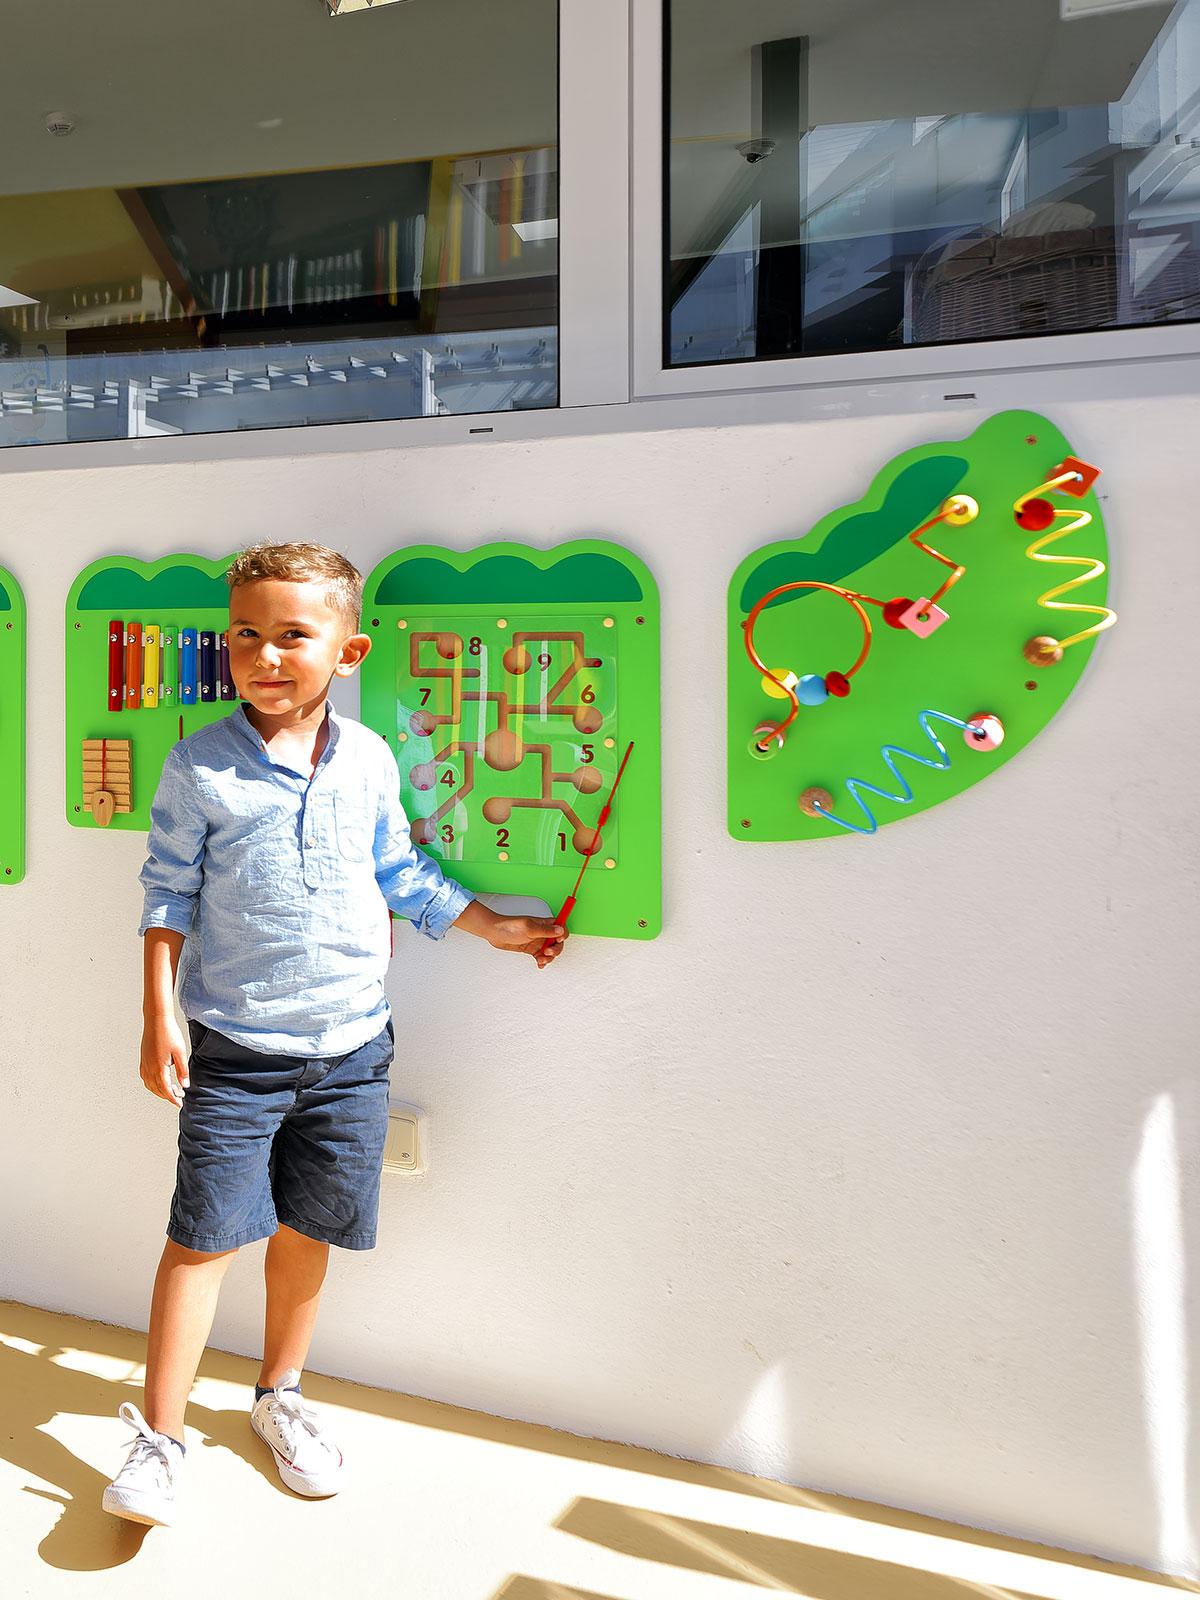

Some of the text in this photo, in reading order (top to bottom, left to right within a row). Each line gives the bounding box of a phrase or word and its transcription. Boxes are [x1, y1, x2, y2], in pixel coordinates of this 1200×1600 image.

[469, 637, 482, 656] 8
[538, 653, 552, 672] 9
[419, 688, 432, 706] 7
[581, 684, 595, 704] 6
[580, 744, 594, 764] 5
[440, 769, 456, 788] 4
[441, 824, 455, 843] 3
[496, 829, 510, 848] 2
[557, 832, 566, 851] 1
